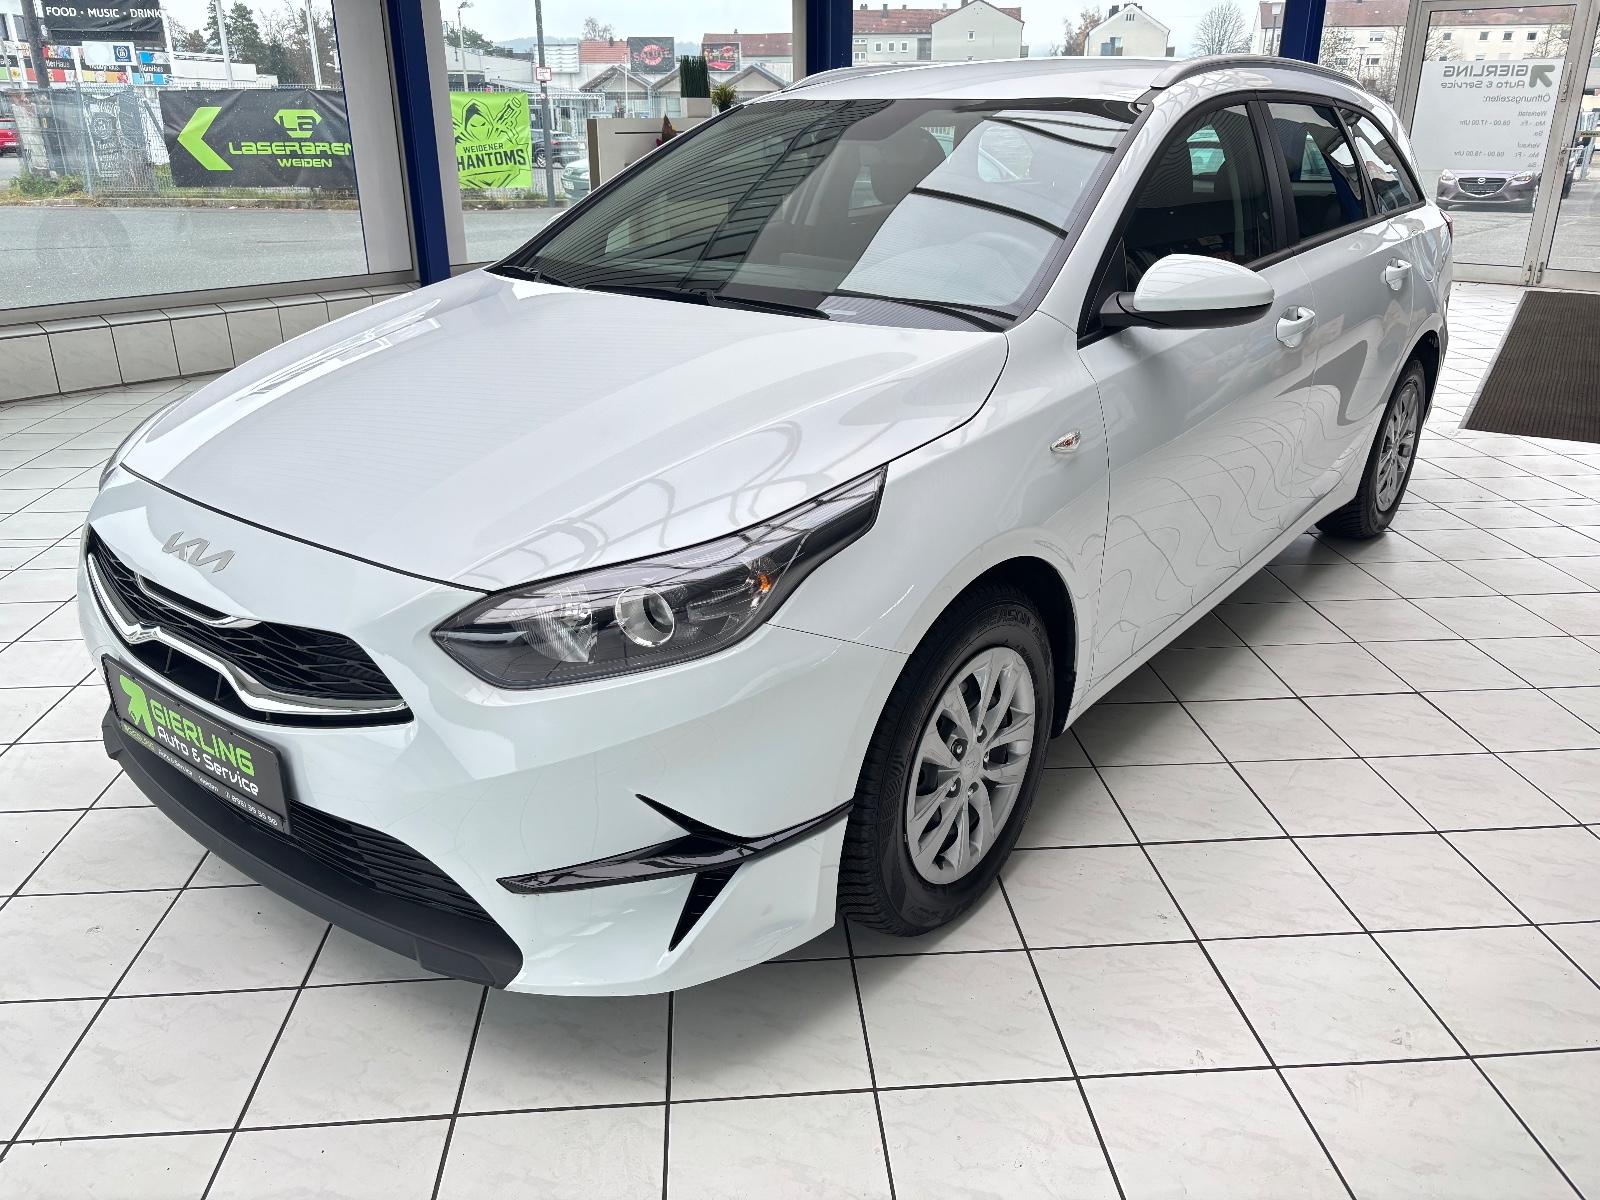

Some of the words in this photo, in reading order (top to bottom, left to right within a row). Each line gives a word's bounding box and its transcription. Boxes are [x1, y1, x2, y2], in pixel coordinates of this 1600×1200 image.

[45, 6, 77, 17] FOOD
[87, 8, 120, 18] MUSIC
[463, 142, 504, 154] WEIDENER
[277, 158, 333, 168] WEIDEN
[150, 699, 256, 777] GIERLING
[157, 725, 189, 757] Auto
[202, 752, 259, 797] Service
